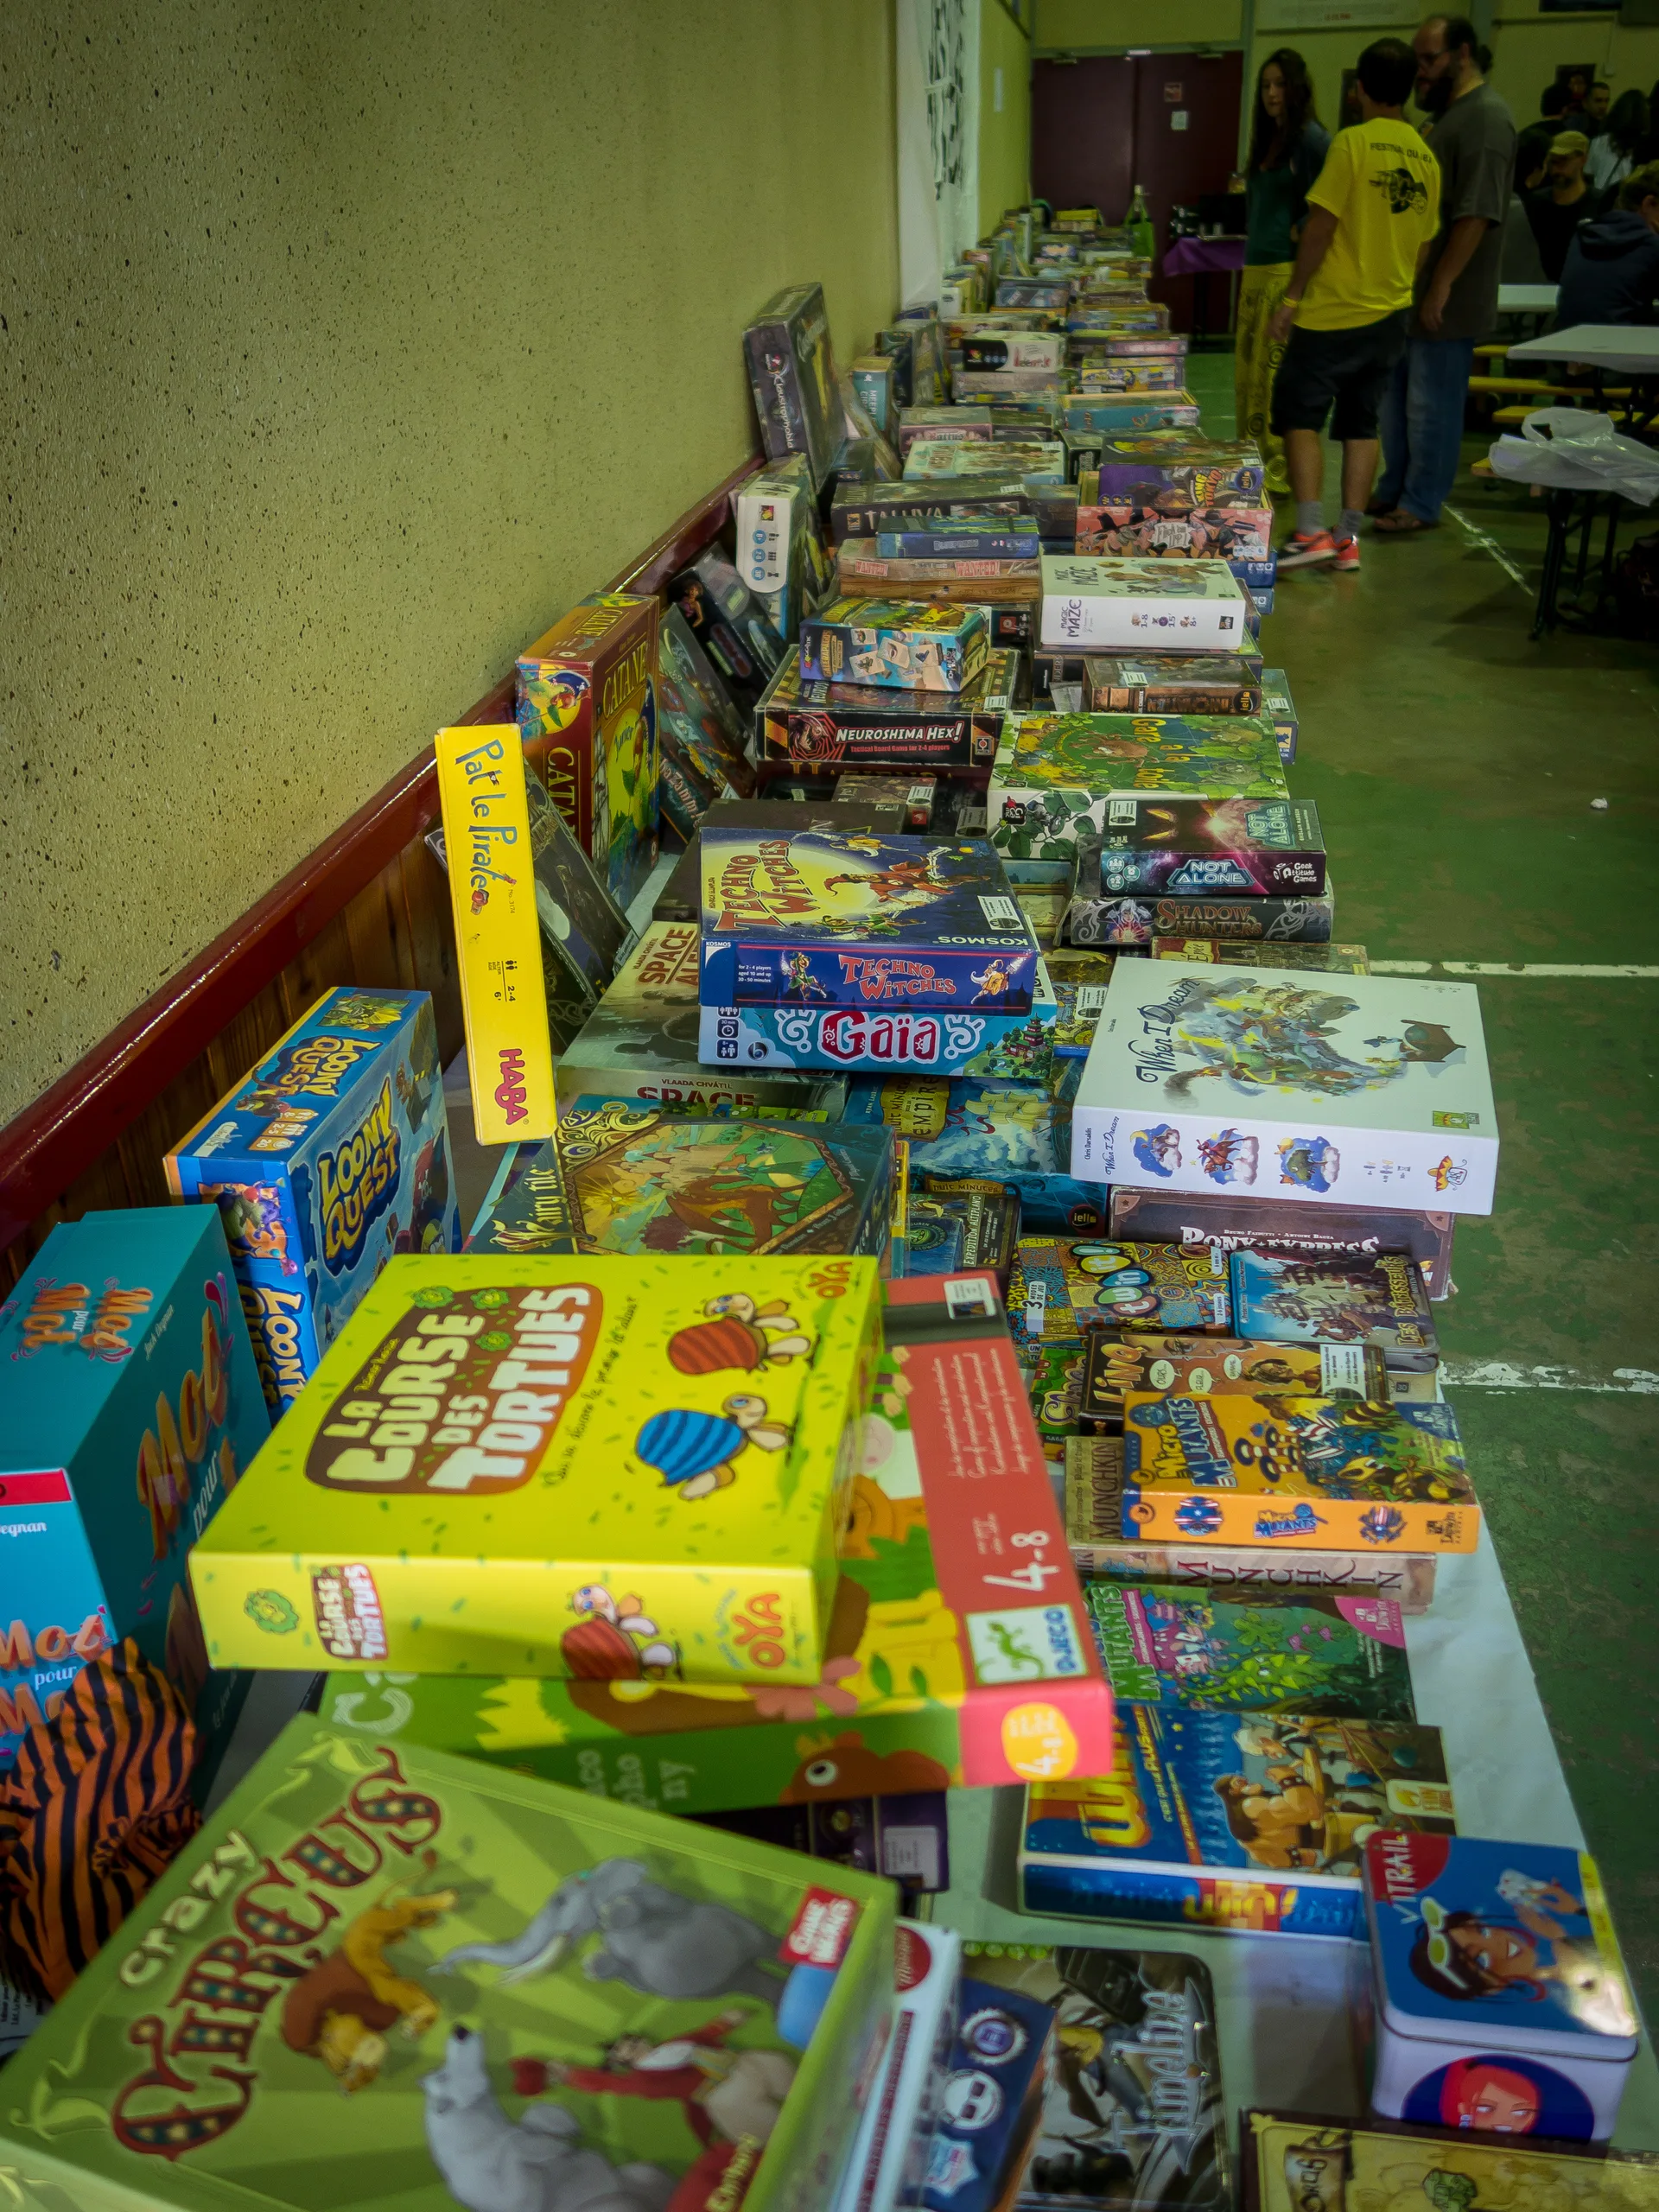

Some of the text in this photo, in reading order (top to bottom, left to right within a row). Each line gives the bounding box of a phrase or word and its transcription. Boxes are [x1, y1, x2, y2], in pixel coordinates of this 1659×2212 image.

[1370, 143, 1405, 156] FESTIVAL
[575, 607, 624, 638] CATANE
[1060, 607, 1069, 629] MAGIC
[1067, 599, 1082, 638] MAZE
[603, 640, 648, 719] CATANE
[810, 680, 830, 704] NEUROS
[836, 721, 965, 743] NEUROSHIMA HEX!
[928, 744, 950, 753] players
[1131, 718, 1167, 744] Gare
[1165, 752, 1204, 763] la
[547, 747, 576, 831] CATA
[1133, 767, 1176, 790] toile
[454, 739, 518, 892] Pat le Pirate
[1267, 805, 1288, 845] ALONE
[1178, 872, 1247, 886] ALONE
[1190, 861, 1233, 873] NOT
[1293, 874, 1317, 883] Games
[1294, 862, 1313, 871] Geek
[713, 853, 761, 932] TECHNO
[1156, 899, 1251, 925] SHADOW
[939, 936, 1029, 946] KOSMOS
[1175, 919, 1262, 936] HUNTERS
[639, 928, 696, 984] SPACE
[838, 955, 936, 983] TECHNO
[821, 1010, 938, 1064] Gaïa
[1128, 978, 1202, 1084] When I Dream
[277, 1037, 340, 1096] QUEST
[302, 1038, 384, 1097] LOONY
[662, 1078, 692, 1087] VLAADA
[494, 1047, 529, 1126] HABA
[318, 1076, 392, 1224] LOONY
[1084, 1127, 1092, 1160] Chris Darsaklis
[1103, 1116, 1120, 1147] Dream
[525, 1167, 558, 1192] tile
[1105, 1156, 1118, 1176] When
[324, 1135, 399, 1260] QUEST
[969, 1195, 982, 1226] ALTIPLANO
[1180, 1226, 1254, 1251] PONY
[806, 1261, 854, 1300] OYA
[73, 1309, 90, 1332] pour
[1022, 1300, 1043, 1310] 3
[1395, 1322, 1424, 1346] LES
[326, 1314, 486, 1482] COURSE
[427, 1286, 593, 1491] TORTUES
[322, 1399, 383, 1438] LA
[431, 1394, 490, 1446] DES
[1166, 1397, 1237, 1488] MUTANTS
[1090, 1440, 1123, 1540] MUNCHKIN
[1254, 1516, 1318, 1538] MUTANTS
[982, 1529, 1061, 1594] 4-8
[1177, 1560, 1405, 1591] MUNCHKIN
[316, 1575, 346, 1656] COURSE
[345, 1563, 386, 1659] TORTUES
[733, 1592, 785, 1671] OYA
[1043, 1609, 1077, 1675] DJECO
[1092, 1585, 1162, 1700] MUTANTS
[35, 1665, 76, 1691] pour
[0, 1682, 66, 1736] Mo
[1016, 1732, 1062, 1778] 4-8
[1135, 1734, 1160, 1773] PLUS
[1382, 1832, 1421, 1926] VITRAIL
[120, 1830, 259, 1988] crazy
[111, 1745, 443, 2162] CIRCUS
[1109, 1989, 1199, 2153] Timeline
